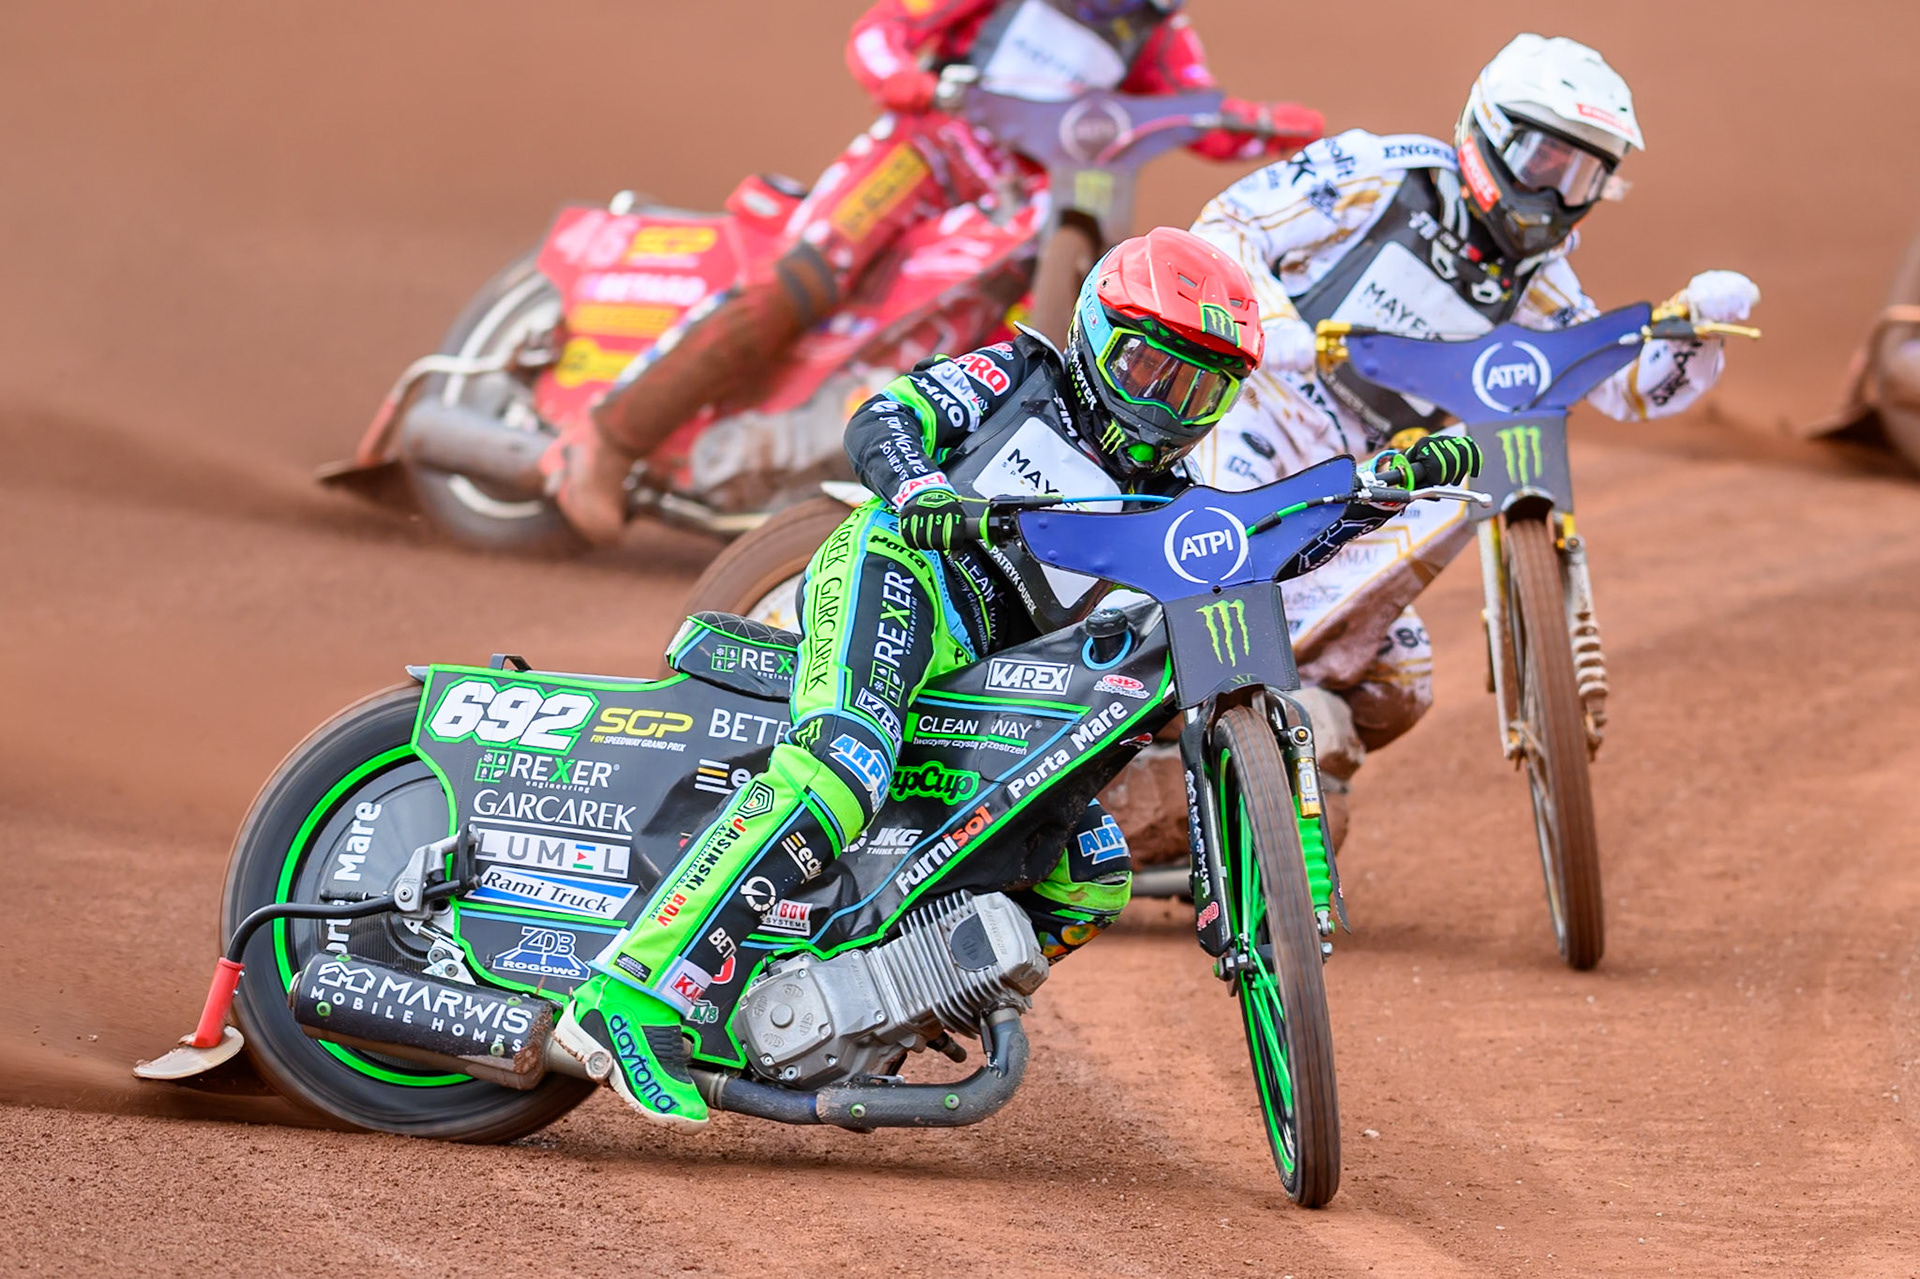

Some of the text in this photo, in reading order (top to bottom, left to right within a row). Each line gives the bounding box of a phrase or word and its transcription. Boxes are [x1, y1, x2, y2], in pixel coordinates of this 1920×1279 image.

[1486, 362, 1536, 391] ATPI
[1054, 396, 1078, 437] FIM
[1007, 448, 1060, 494] MAY
[902, 513, 962, 530] FIST
[1180, 529, 1234, 561] ATPI
[989, 545, 1038, 616] PATRYK DUDEK
[808, 577, 842, 691] GARCAREK
[874, 570, 914, 668] REXER
[905, 597, 918, 655] engineering
[741, 648, 795, 676] REX
[990, 661, 1066, 692] KAREX
[430, 681, 595, 751] 692
[593, 707, 694, 738] SGP
[918, 716, 1032, 740] CLEAN WAY
[590, 734, 687, 752] FIM SPEEDWAY GRAND PRIX
[1007, 701, 1128, 799] Porta Mare
[510, 753, 612, 788] REXER
[526, 781, 591, 794] engineering
[473, 789, 637, 832] GARCAREK
[333, 801, 382, 882] Mare
[867, 847, 894, 856] THINK
[869, 827, 923, 846] JKG
[1079, 825, 1125, 856] ARP
[657, 818, 747, 927] JASINSKI BOV
[484, 871, 612, 913] Rami Truck
[766, 917, 808, 928] SYSTEME
[779, 902, 808, 920] BOV
[521, 926, 577, 958] ZDB
[502, 960, 581, 977] ROGOWO
[310, 986, 522, 1052] MOBILE HOMES
[377, 975, 533, 1034] MARWIS
[609, 1014, 680, 1114] daytona
